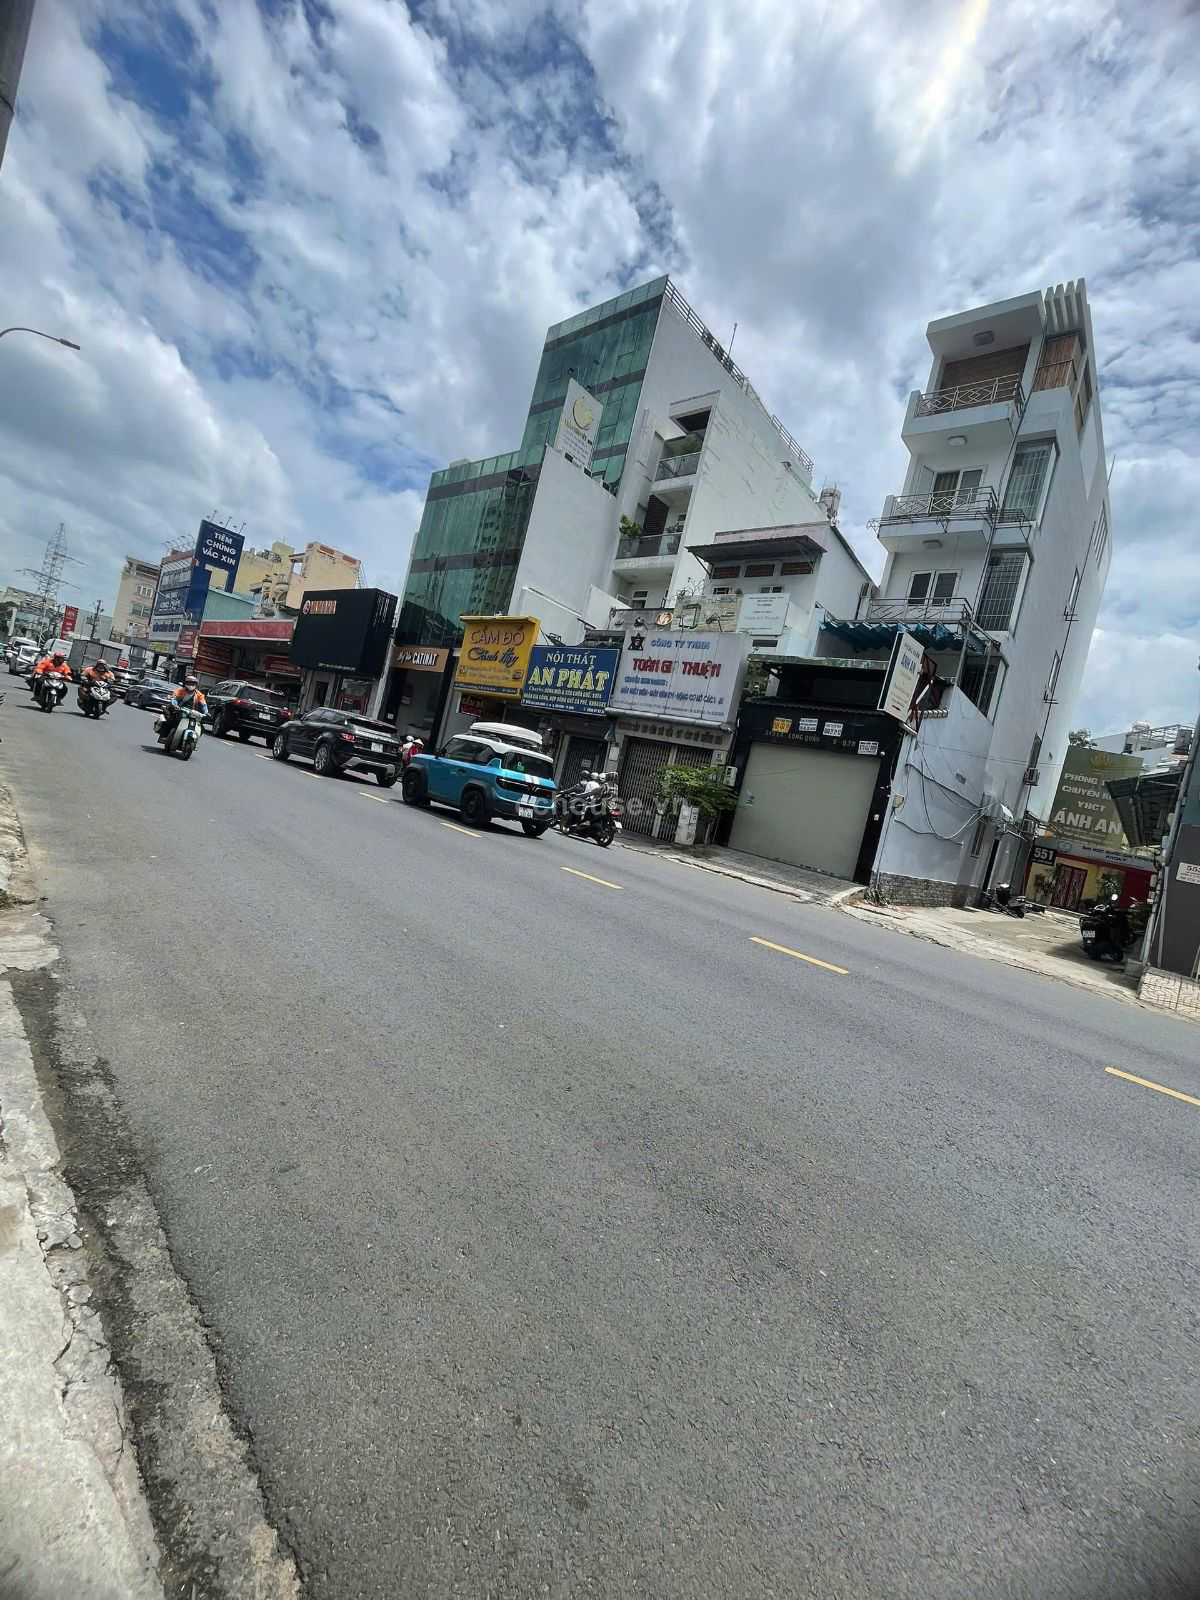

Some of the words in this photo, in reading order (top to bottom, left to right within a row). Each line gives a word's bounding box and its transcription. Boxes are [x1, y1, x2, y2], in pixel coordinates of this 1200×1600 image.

[221, 554, 236, 566] XIN
[650, 638, 672, 648] CÔNG
[674, 640, 686, 649] TY
[412, 652, 438, 666] CATINAT
[545, 650, 564, 665] NỘI
[566, 650, 597, 665] THẤT
[633, 656, 660, 673] TOÀN
[682, 660, 722, 679] THUẬN
[527, 665, 556, 686] AN
[556, 664, 610, 691] PHÁT
[1063, 772, 1099, 786] PHÒNG
[1061, 785, 1101, 799] CHUYÊN
[1077, 800, 1107, 812] YHCT
[1053, 807, 1093, 829] ÁNH
[1094, 818, 1122, 835] AN
[1033, 847, 1054, 860] 551
